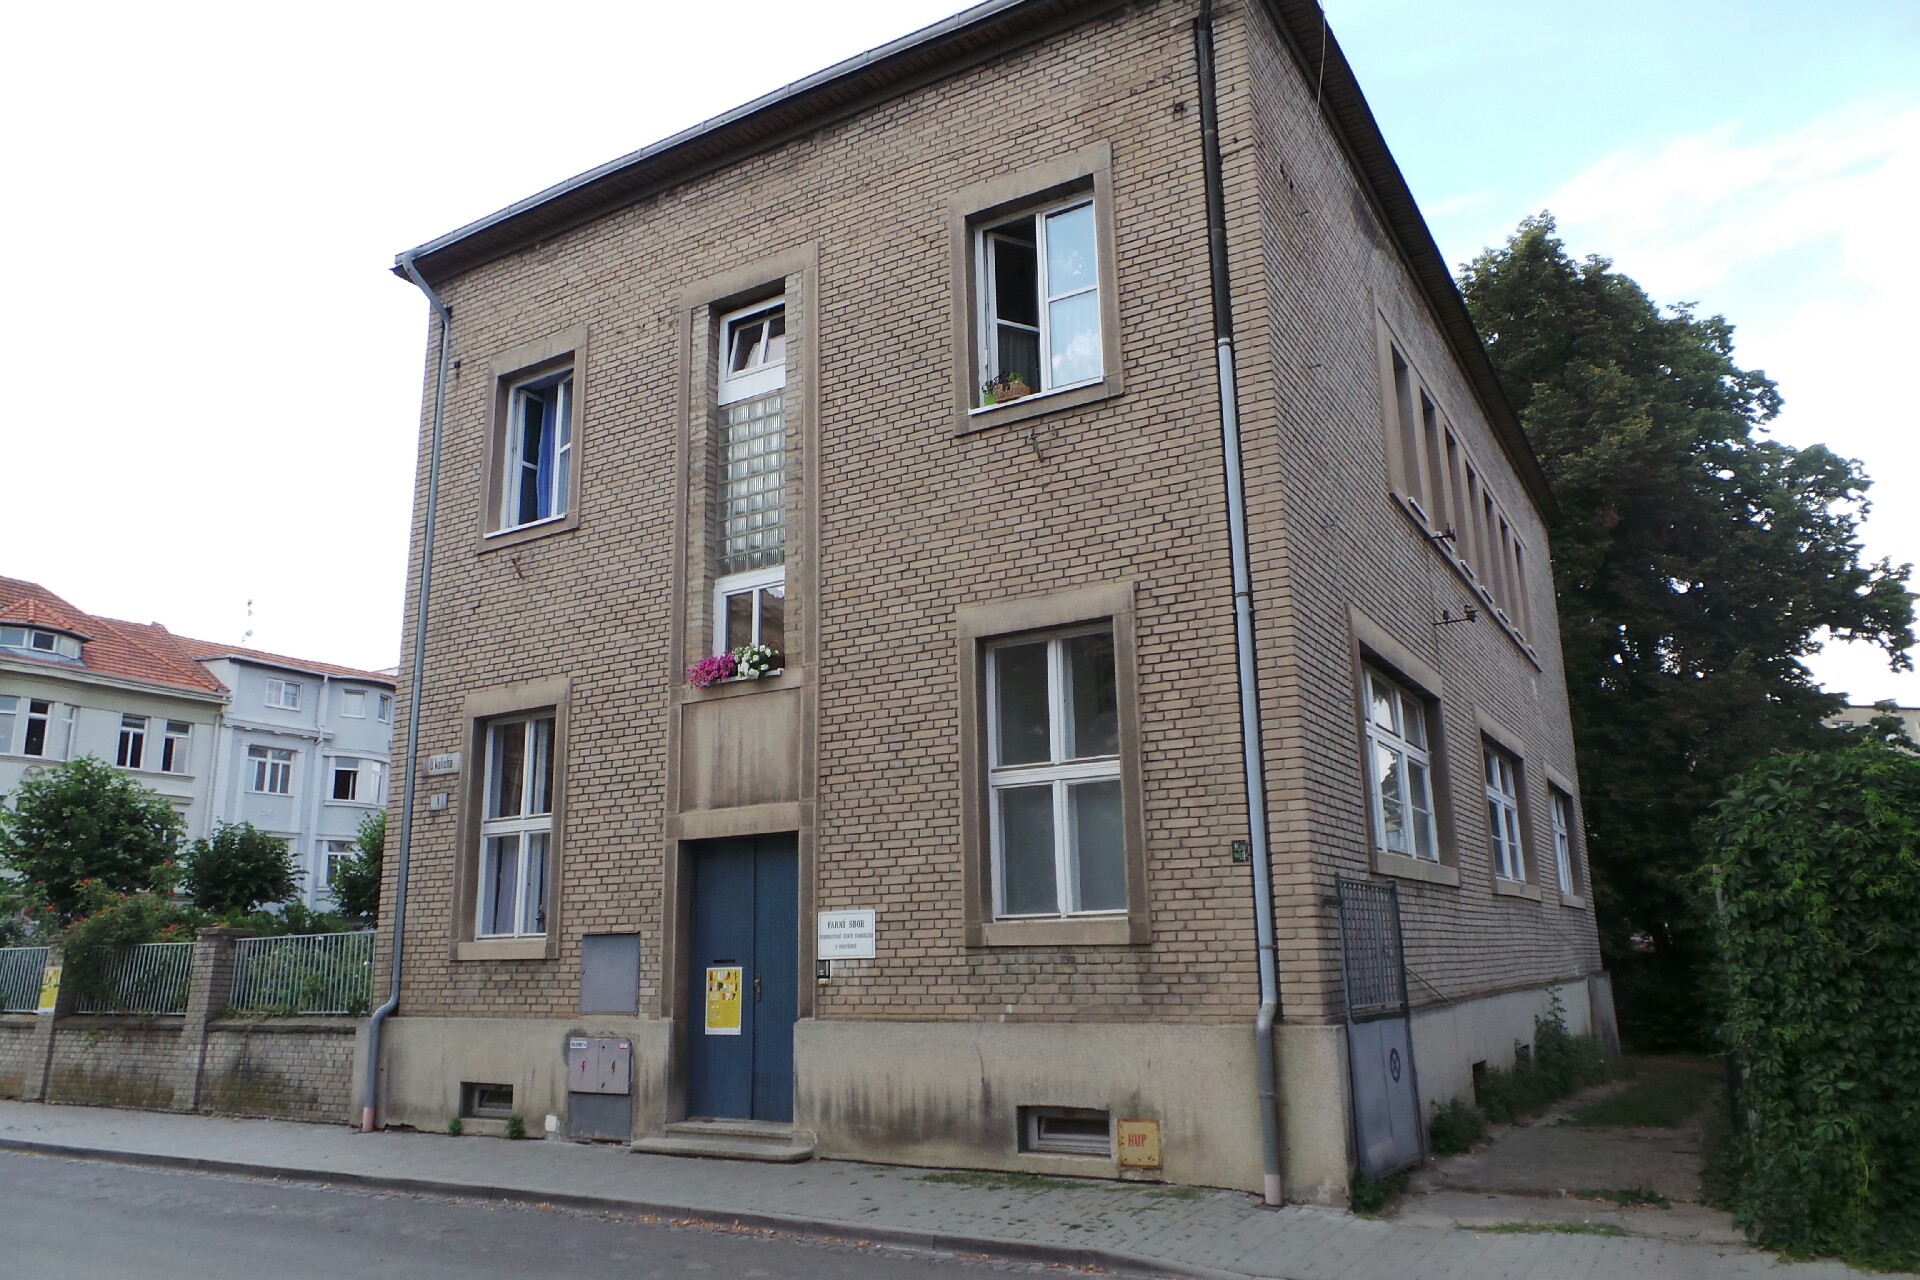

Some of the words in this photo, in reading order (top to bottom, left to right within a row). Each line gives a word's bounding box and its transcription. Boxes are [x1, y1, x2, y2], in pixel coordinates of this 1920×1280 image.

[827, 918, 846, 929] FARNÍ
[849, 920, 865, 929] SBOR
[1128, 1134, 1147, 1147] HUP
